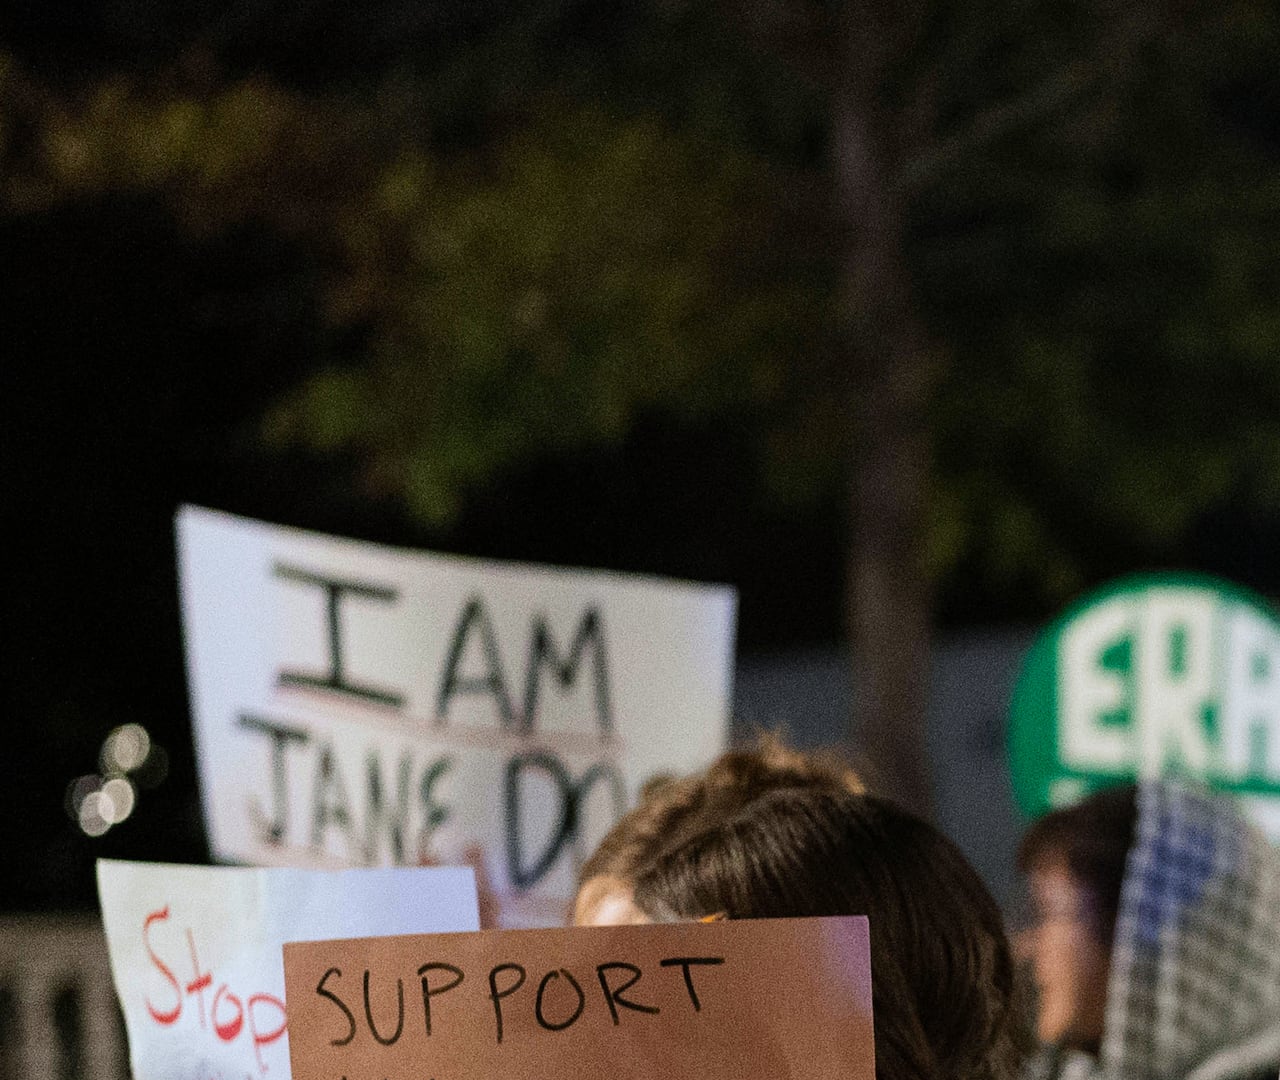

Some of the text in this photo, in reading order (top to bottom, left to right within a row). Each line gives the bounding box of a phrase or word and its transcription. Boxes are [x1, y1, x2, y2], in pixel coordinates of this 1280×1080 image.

[273, 558, 615, 738] I AM
[234, 708, 632, 892] JANE DO
[143, 903, 289, 1075] Stop
[315, 956, 726, 1048] SUPPORT
